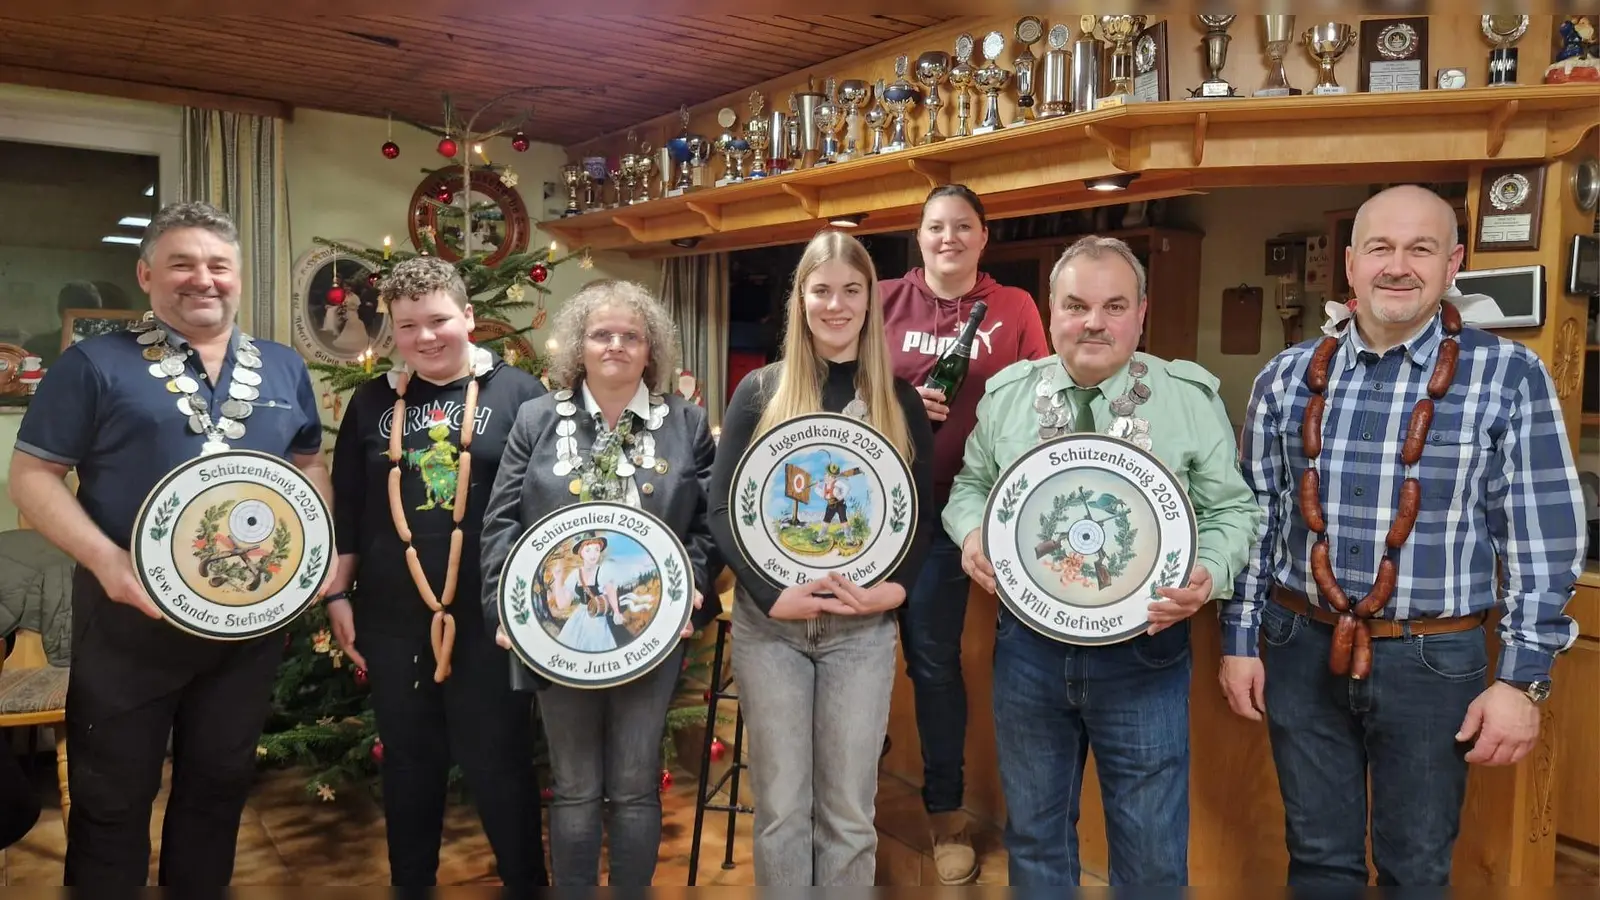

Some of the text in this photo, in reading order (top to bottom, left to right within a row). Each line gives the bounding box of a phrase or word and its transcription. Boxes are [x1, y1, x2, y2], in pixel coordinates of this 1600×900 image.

[769, 424, 885, 460] Jugendkönig 2025
[198, 464, 321, 522] Schützenkönig 2025
[1048, 447, 1180, 521] Schützenkönig 2025
[531, 513, 652, 552] Schützenliesl 2025
[763, 557, 790, 581] gew.
[841, 560, 877, 583] leber
[148, 565, 286, 628] gew. Sandro Stefinger
[995, 558, 1124, 633] gew. Willi Stefinger
[546, 637, 660, 674] gew. Jutta Fuchs
